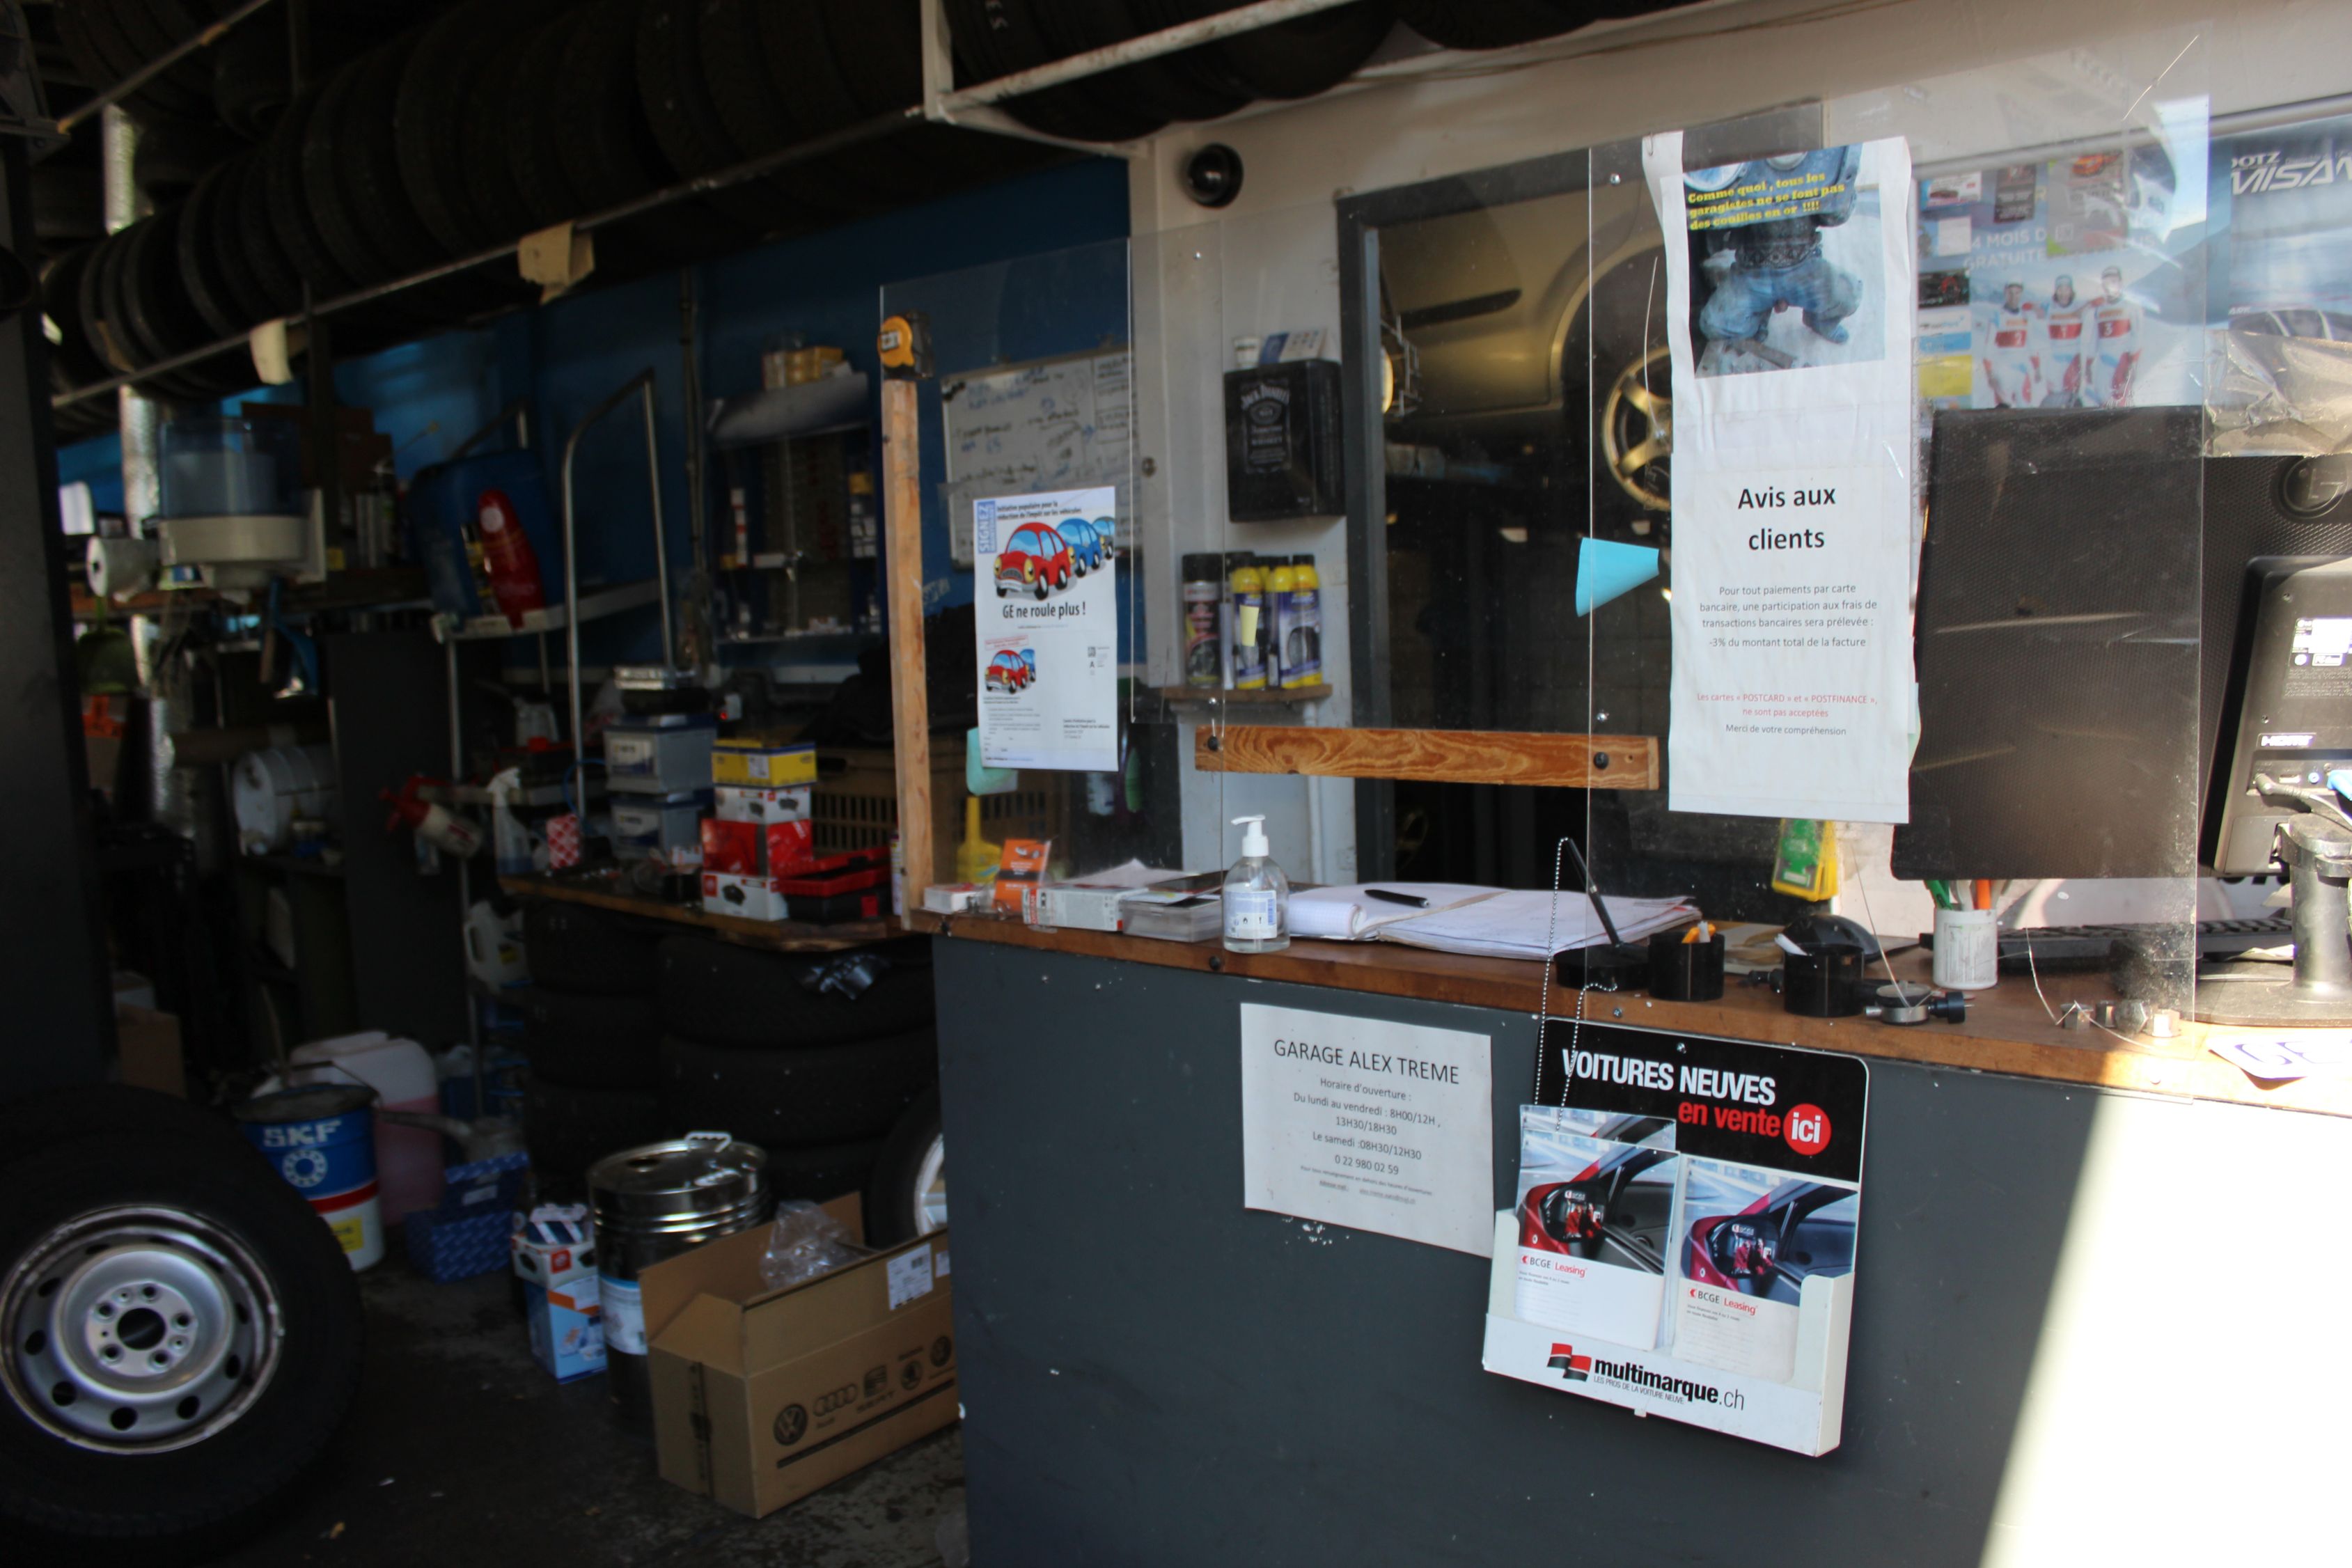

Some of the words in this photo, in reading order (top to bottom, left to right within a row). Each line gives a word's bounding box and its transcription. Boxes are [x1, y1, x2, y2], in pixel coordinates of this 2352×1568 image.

[1688, 188, 1734, 203] Comme
[1737, 182, 1766, 196] quoi
[1775, 177, 1803, 189] tous
[1806, 172, 1825, 184] les
[1689, 198, 1754, 219] garagistes
[1757, 196, 1772, 205] ne
[1775, 193, 1790, 203] se
[1792, 188, 1819, 201] font
[1821, 184, 1845, 198] pas
[1690, 219, 1710, 230] des
[1713, 212, 1762, 226] couilles
[1765, 208, 1781, 218] en
[1784, 205, 1798, 215] or
[1987, 229, 2030, 248] MOIS
[1739, 487, 1786, 510] Avis
[1794, 487, 1836, 507] aux
[978, 504, 989, 552] SIGNEZ
[1748, 527, 1825, 551] clients
[1719, 587, 1740, 595] Pour
[1742, 586, 1760, 595] tout
[1764, 585, 1810, 597] paiements
[1814, 586, 1829, 595] par
[1832, 584, 1856, 593] carte
[1003, 604, 1014, 618] GE
[1016, 608, 1028, 618] ne
[1030, 604, 1056, 617] roule
[1059, 602, 1079, 620] plus
[1700, 602, 1739, 613] bancaire,
[1762, 602, 1820, 613] participation
[1842, 600, 1863, 609] frais
[1865, 600, 1877, 609] de
[1702, 619, 1756, 627] transactions
[1759, 618, 1802, 627] bancaires
[1827, 617, 1868, 629] prélevée
[1709, 638, 1725, 647] -3%
[1728, 638, 1740, 647] du
[1742, 638, 1780, 647] montant
[1782, 638, 1804, 647] total
[1808, 638, 1818, 647] de
[1821, 638, 1829, 646] la
[1832, 637, 1866, 647] facture
[1743, 693, 1785, 702] POSTCARD
[1794, 694, 1802, 703] et
[1812, 694, 1867, 704] POSTFINANCE
[1755, 708, 1771, 716] sont
[1774, 709, 1786, 719] pas
[1789, 709, 1828, 719] acceptées
[1726, 725, 1747, 733] Merci
[1750, 725, 1759, 733] de
[1762, 726, 1782, 734] votre
[1785, 726, 1846, 736] compréhension
[1274, 1040, 1344, 1066] GARAGE
[1349, 1051, 1393, 1073] ALEX
[1397, 1057, 1459, 1085] TREME
[1321, 1078, 1351, 1092] Horaire
[1562, 1049, 1673, 1092] VOITURES
[1679, 1065, 1775, 1106] NEUVES
[1294, 1092, 1306, 1101] Du
[1308, 1095, 1328, 1107] lundi
[1331, 1099, 1341, 1109] au
[1344, 1101, 1383, 1116] vendredi
[1390, 1108, 1436, 1126] 8H00/12H
[262, 1119, 342, 1147] SKF
[1336, 1116, 1397, 1135] 13H30/18H30
[1679, 1101, 1706, 1124] en
[1714, 1104, 1781, 1136] vente
[1791, 1109, 1821, 1144] ici
[1313, 1131, 1322, 1141] Le
[1324, 1132, 1356, 1147] samedi
[1335, 1154, 1340, 1163] 0
[1343, 1156, 1353, 1167] 22
[1356, 1159, 1372, 1170] 980
[1374, 1162, 1385, 1172] 02
[1388, 1164, 1399, 1175] 59
[1530, 1255, 1551, 1269] BCGE
[1555, 1261, 1586, 1278] Leasing
[1698, 1287, 1720, 1305] BCGE
[1723, 1296, 1756, 1315] Leasing
[1594, 1376, 1604, 1384] LES
[1606, 1379, 1621, 1389] PROS
[1631, 1384, 1639, 1393] LA
[1640, 1386, 1663, 1399] VOITURE
[1665, 1393, 1684, 1404] NEUVE
[1595, 1359, 1744, 1411] multimarque.ch
